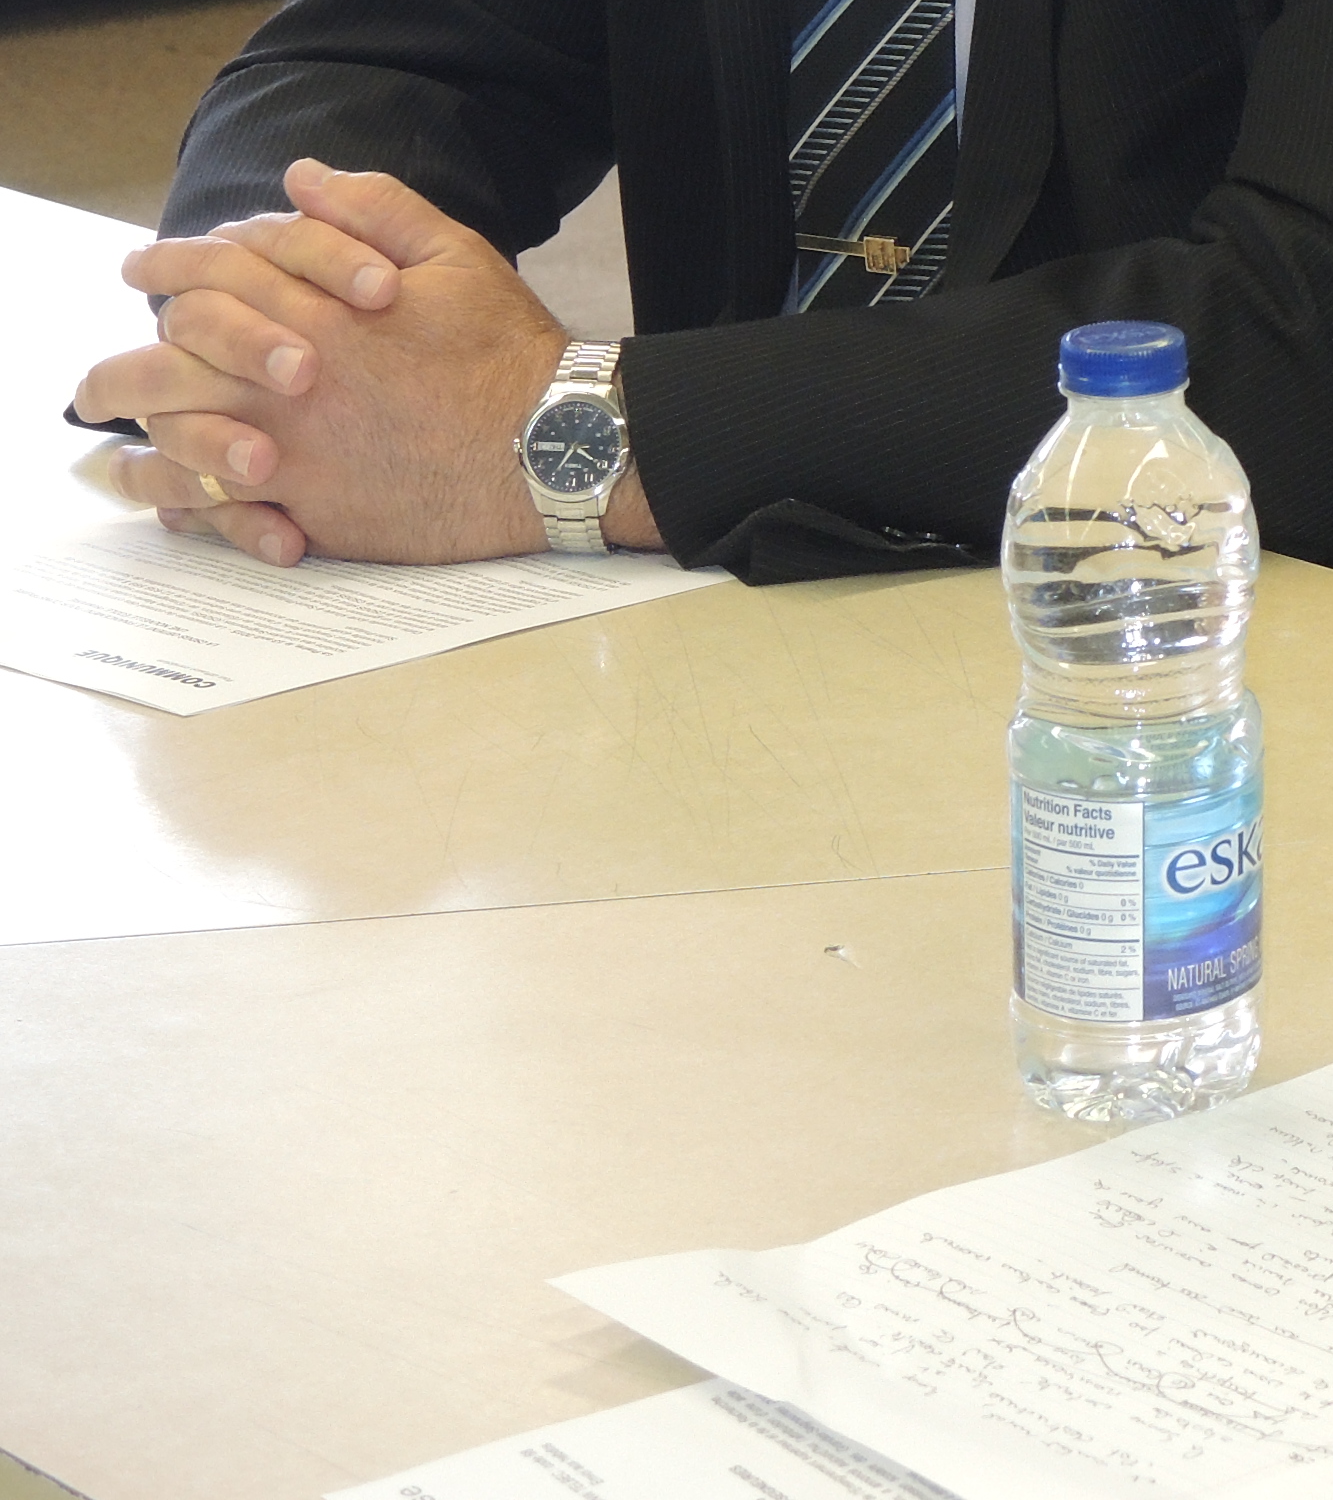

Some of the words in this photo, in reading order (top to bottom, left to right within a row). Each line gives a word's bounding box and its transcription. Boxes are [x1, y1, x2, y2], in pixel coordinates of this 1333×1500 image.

[73, 648, 218, 691] COMMUNIQUÉ
[1024, 790, 1070, 817] Nutrition
[1074, 804, 1112, 821] Facts
[1024, 812, 1054, 830] Valeur
[1058, 823, 1115, 840] nutritive
[1057, 838, 1068, 848] par
[1069, 840, 1082, 849] 500
[1097, 859, 1115, 870] Daily
[1116, 860, 1137, 868] Value
[1073, 866, 1094, 876] valeur
[1095, 869, 1137, 877] quotidienne
[1049, 875, 1078, 889] Calories
[1120, 898, 1127, 907] 0
[1128, 899, 1136, 907] %
[1067, 909, 1099, 921] Glucides
[1120, 913, 1127, 922] 0
[1128, 913, 1136, 922] %
[1120, 945, 1127, 953] 2
[1128, 945, 1136, 953] %
[1167, 956, 1227, 991] NATURAL
